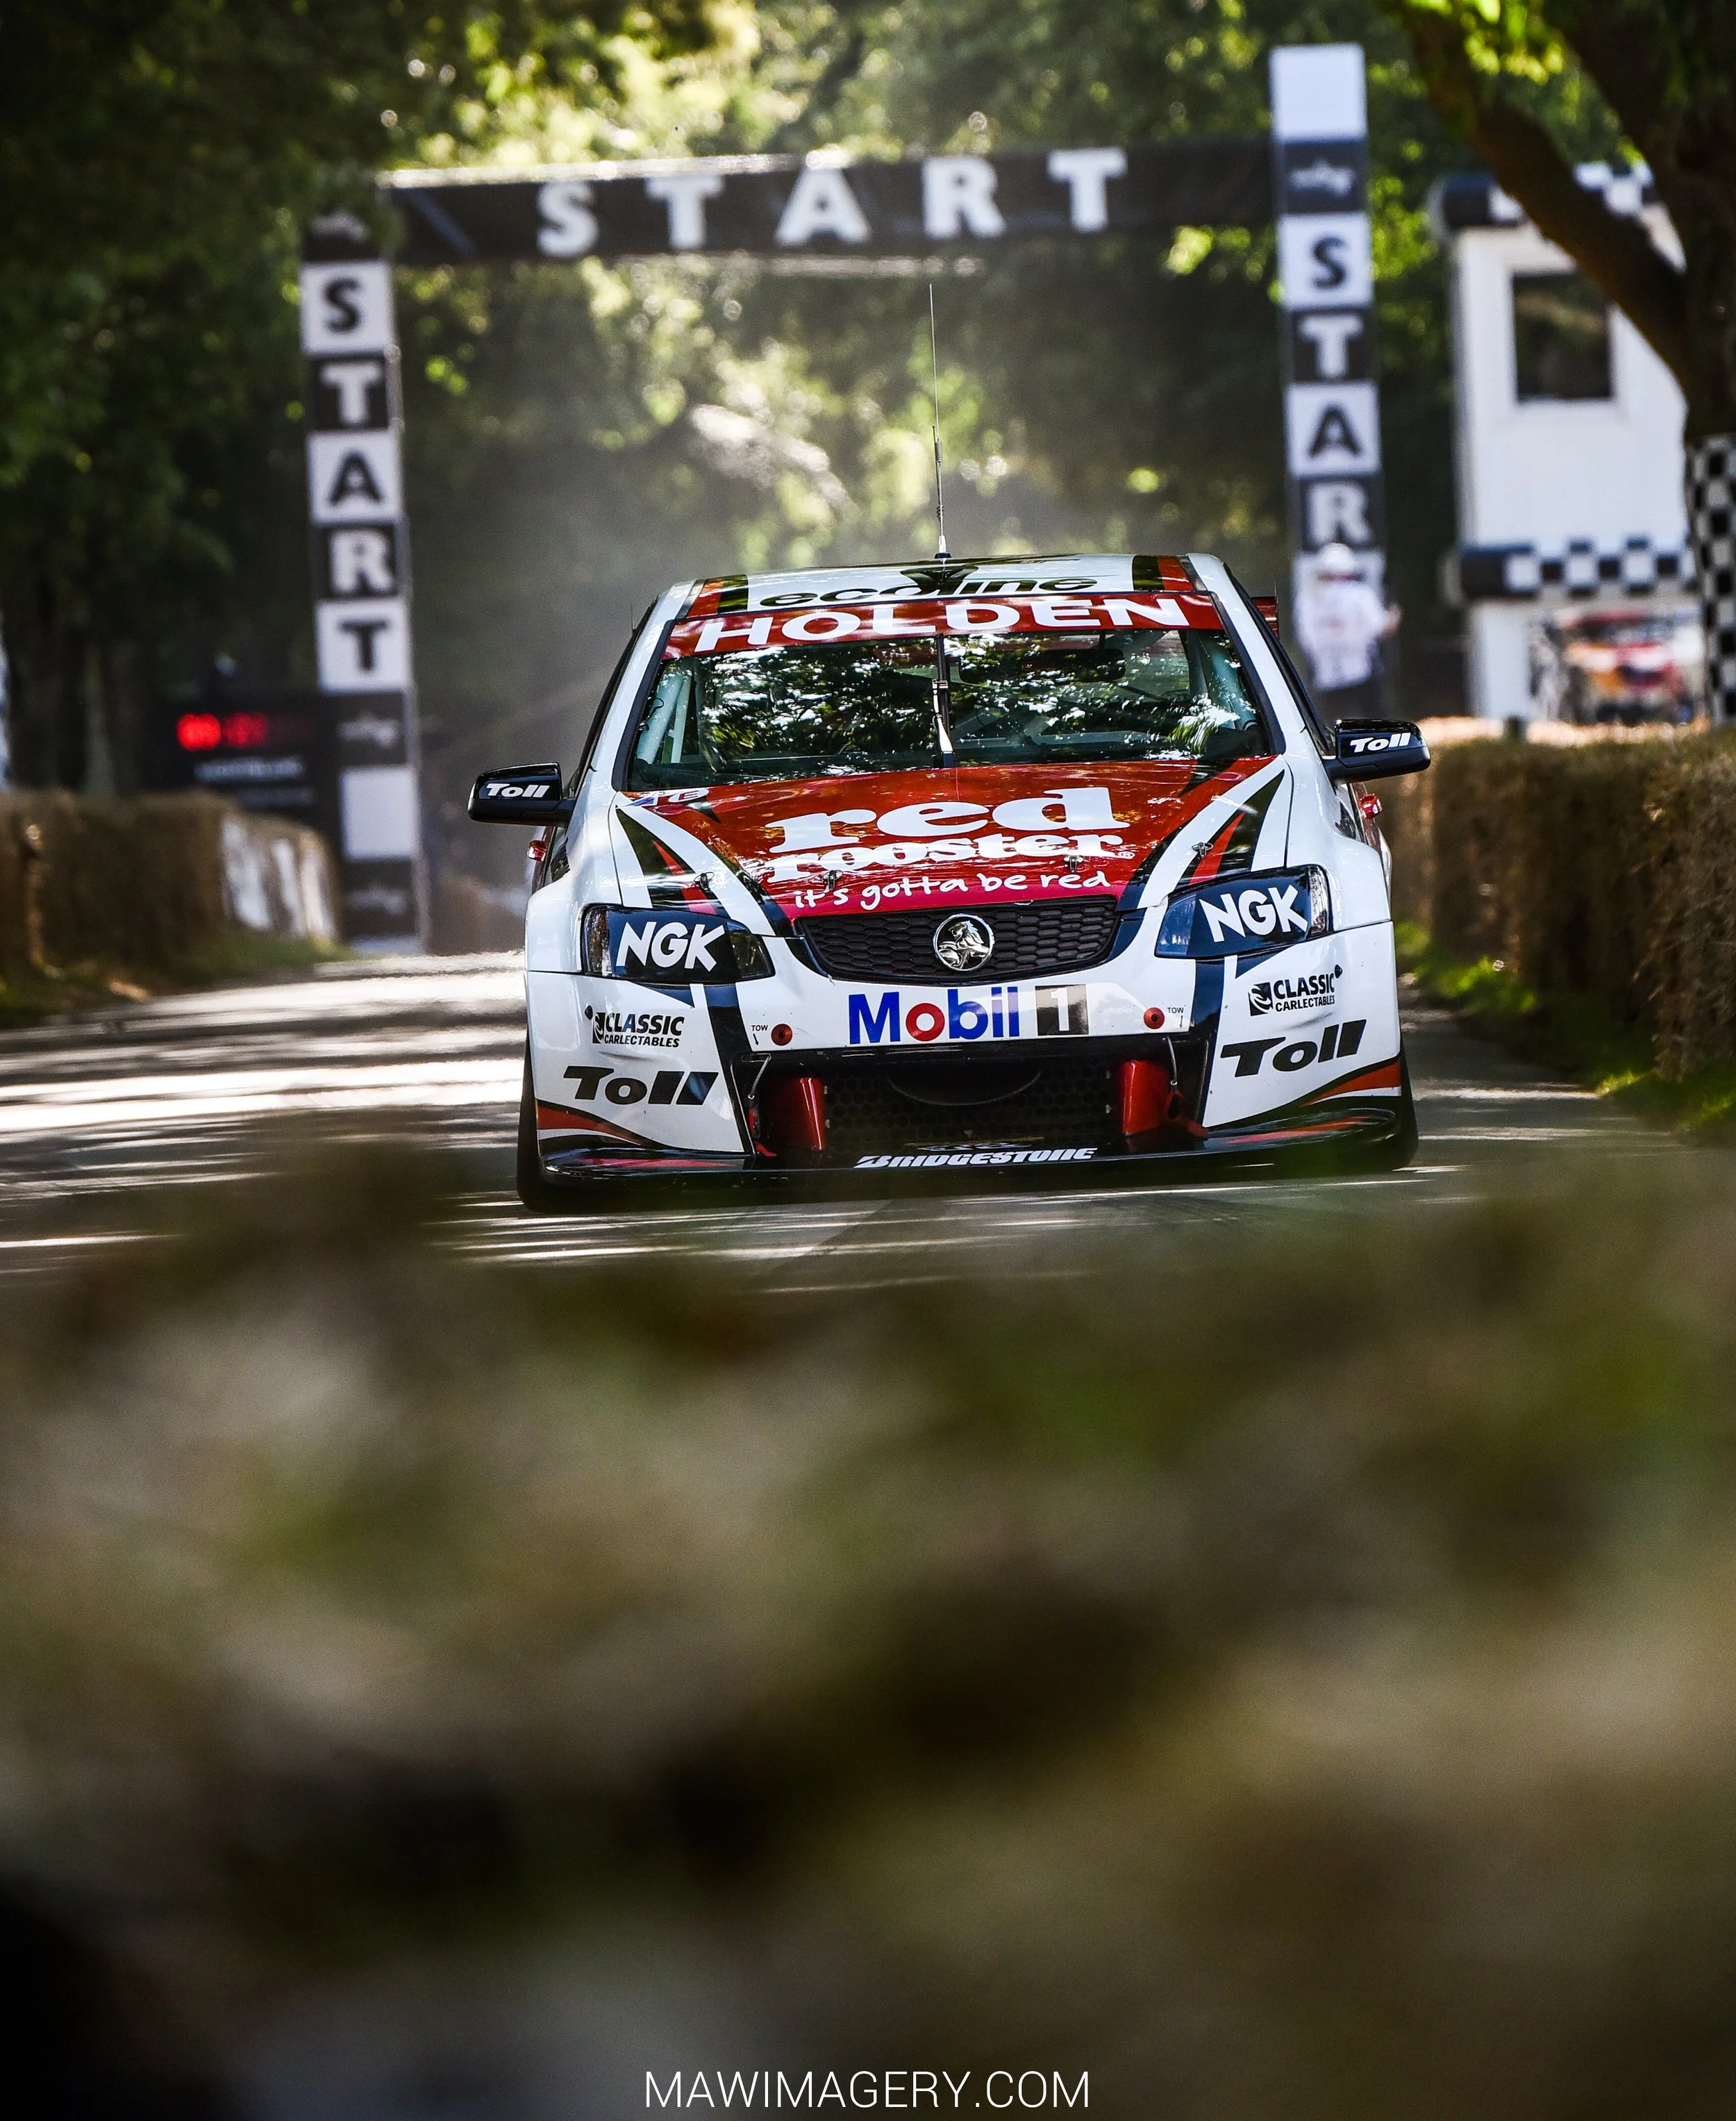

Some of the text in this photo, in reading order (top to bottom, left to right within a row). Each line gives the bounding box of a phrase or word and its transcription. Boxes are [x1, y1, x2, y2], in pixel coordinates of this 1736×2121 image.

[536, 148, 1126, 257] START
[1299, 236, 1374, 590] STAR
[322, 279, 401, 673] START
[694, 598, 1190, 652] HOLDEN
[1350, 732, 1411, 753] Toll
[486, 783, 551, 798] Toll
[765, 787, 1130, 853] red
[794, 871, 1111, 910] it's gotta be red
[1199, 885, 1308, 942] NGK
[615, 921, 726, 972] NGK
[1273, 973, 1335, 999] CLASSIC
[1275, 995, 1335, 1013] CARLECTABLES
[605, 1013, 685, 1036] CLASSIC
[849, 986, 1069, 1045] Mobil 1
[604, 1034, 680, 1048] CARLECTABLES
[1220, 1019, 1367, 1078] Toll
[563, 1066, 719, 1106] Toll
[853, 1147, 1098, 1168] BRIDGESTONE
